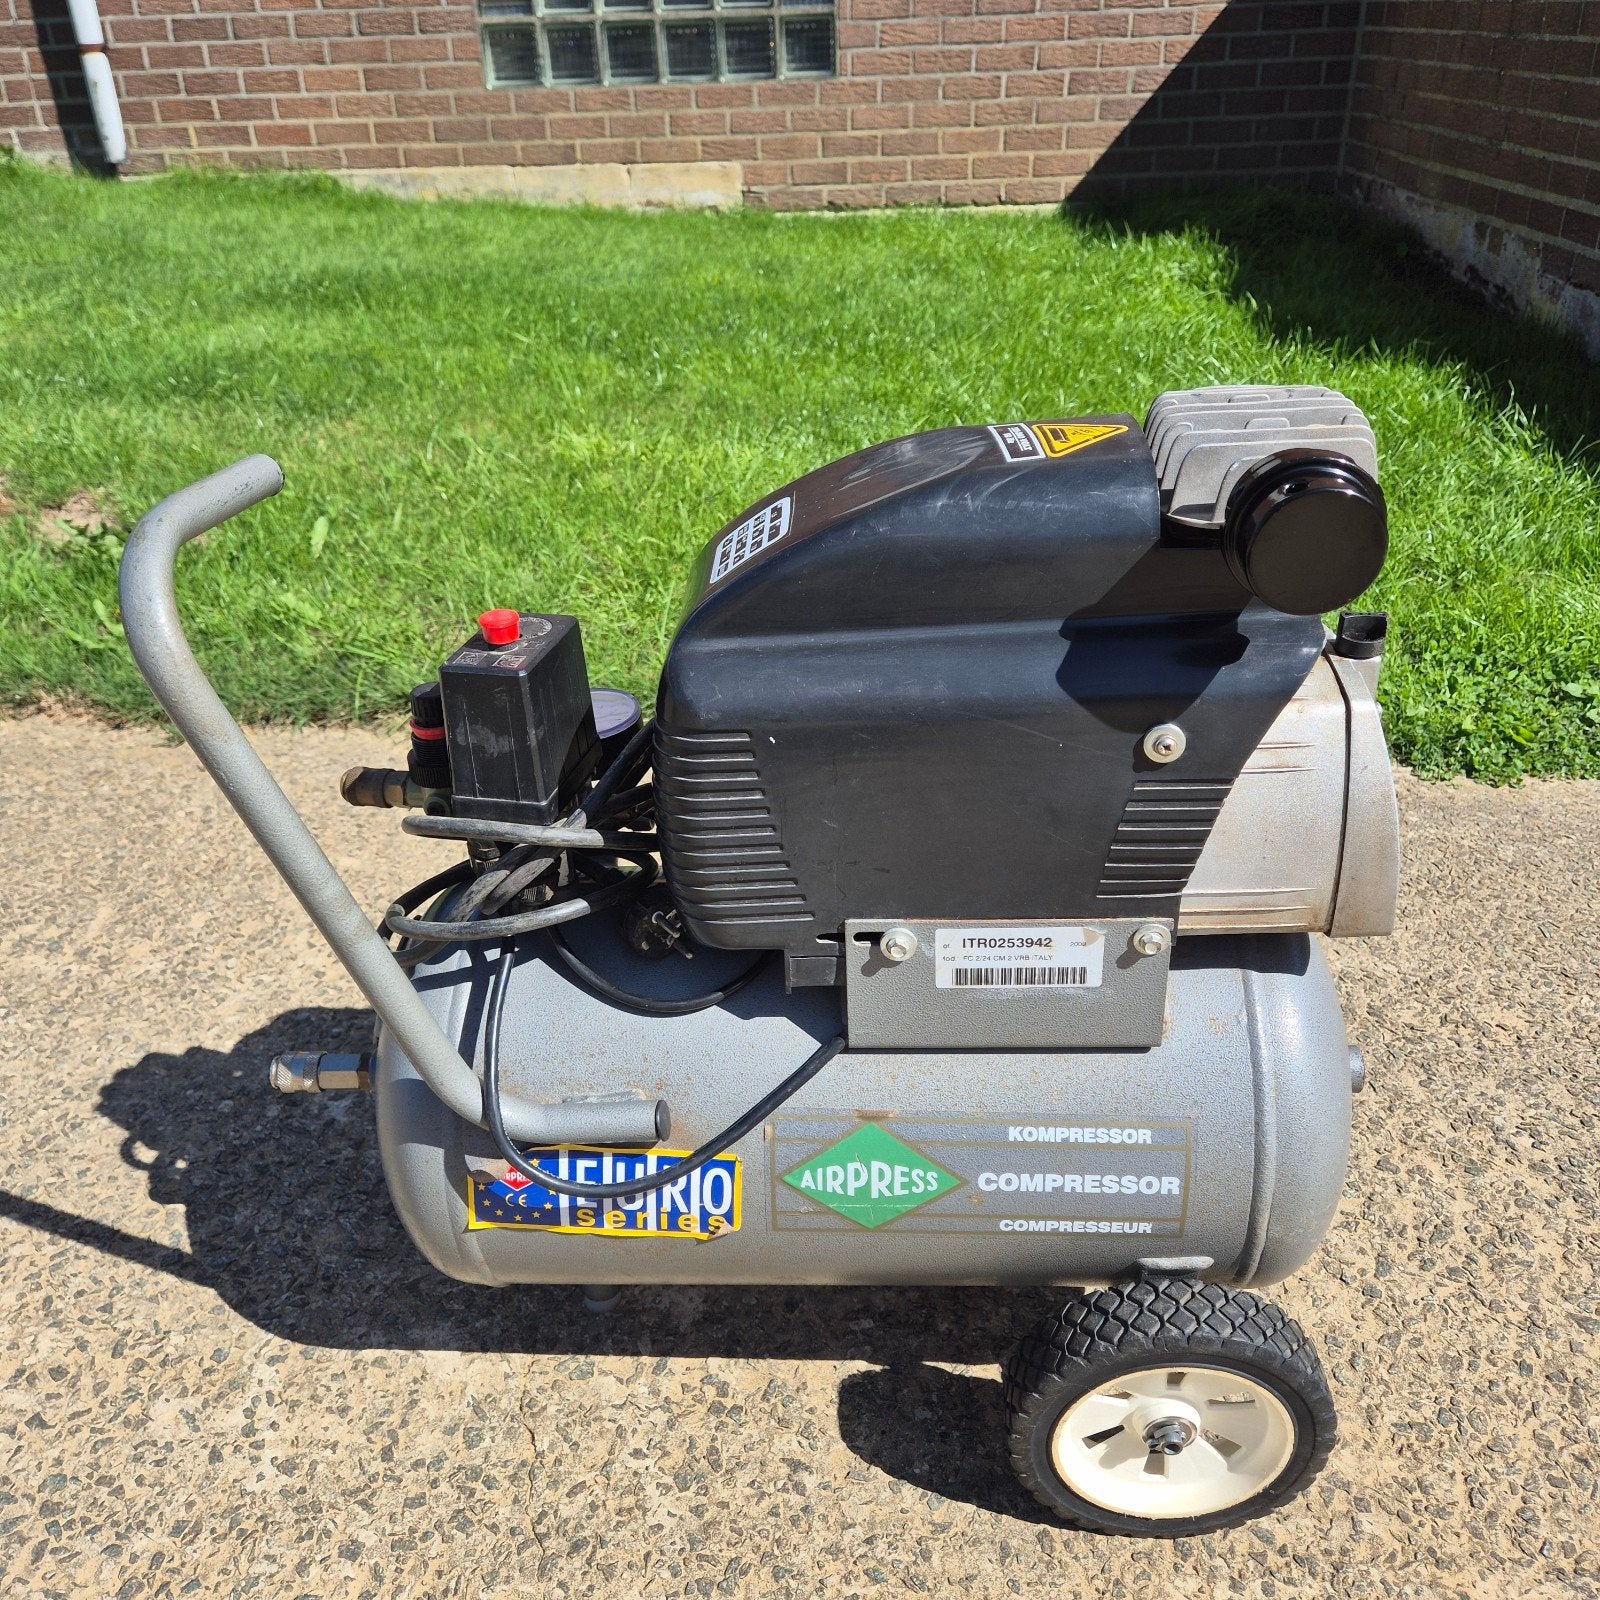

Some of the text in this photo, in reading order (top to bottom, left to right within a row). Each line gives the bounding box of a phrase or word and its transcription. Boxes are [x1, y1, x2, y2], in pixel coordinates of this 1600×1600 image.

[962, 937, 1053, 949] ITR0253942
[1008, 1126, 1152, 1145] KOMPRESSOR
[576, 1159, 732, 1215] EURO
[800, 1160, 939, 1199] AIRPRESS
[977, 1172, 1181, 1196] COMPRESSOR
[576, 1206, 726, 1235] series
[999, 1219, 1152, 1235] COMPRESSEUR
